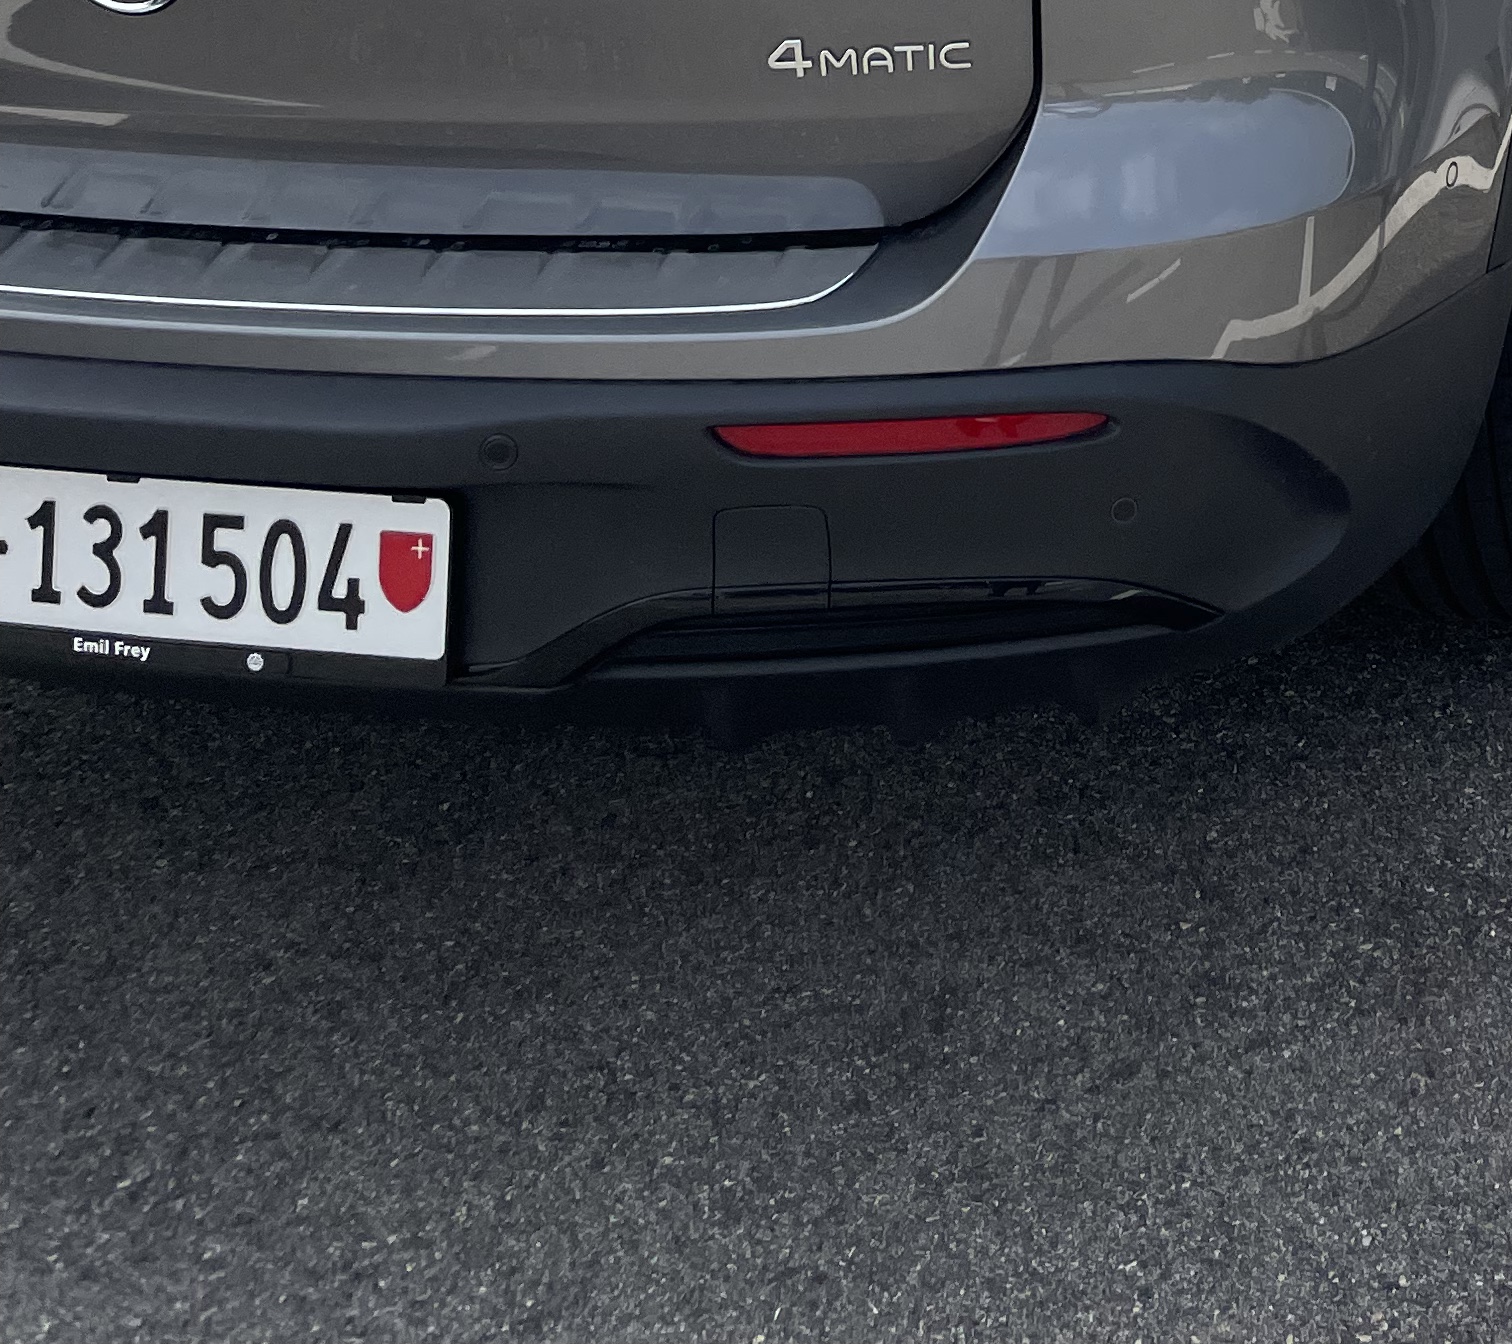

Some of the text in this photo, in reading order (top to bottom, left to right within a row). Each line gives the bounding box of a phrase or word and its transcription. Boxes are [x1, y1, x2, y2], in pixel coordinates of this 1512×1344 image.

[767, 38, 973, 78] 4MATIC
[73, 637, 150, 662] Emil Frey
